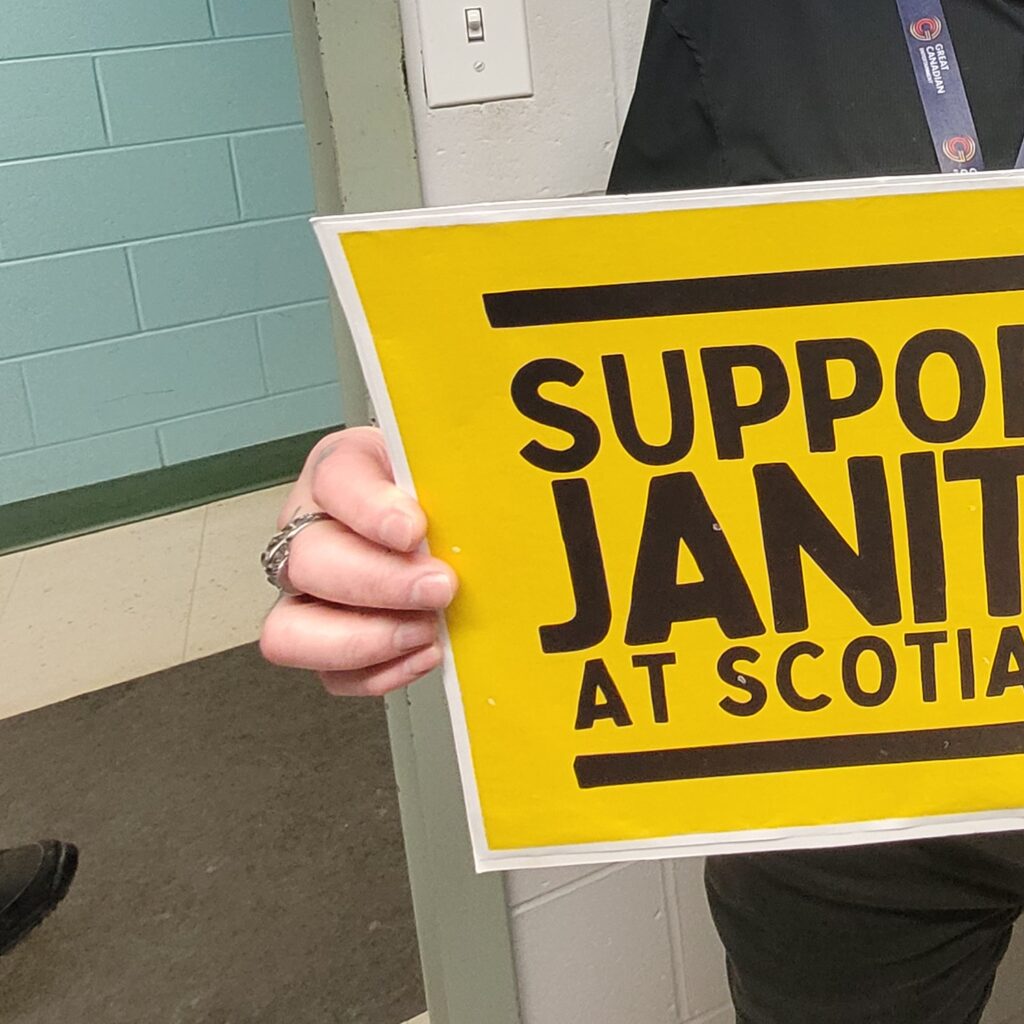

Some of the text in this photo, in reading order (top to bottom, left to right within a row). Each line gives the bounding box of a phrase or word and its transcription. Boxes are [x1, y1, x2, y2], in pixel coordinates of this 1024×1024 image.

[926, 45, 946, 94] CANADIAN
[935, 43, 950, 71] GREAT
[575, 652, 676, 730] AT
